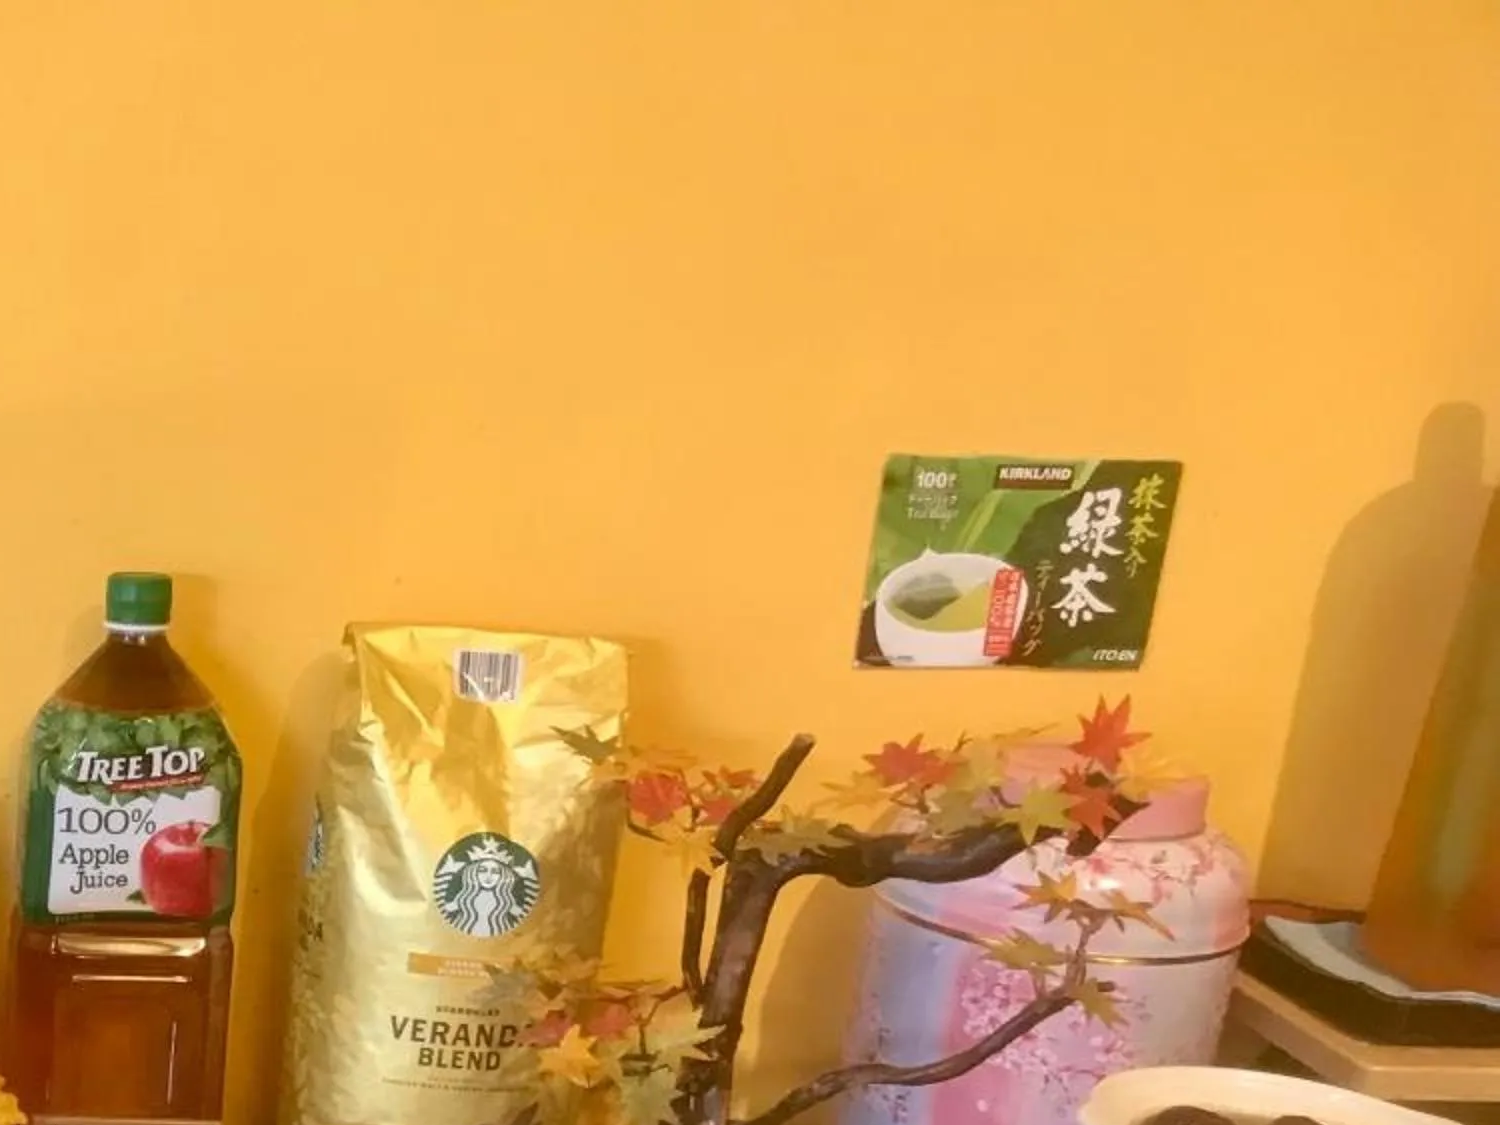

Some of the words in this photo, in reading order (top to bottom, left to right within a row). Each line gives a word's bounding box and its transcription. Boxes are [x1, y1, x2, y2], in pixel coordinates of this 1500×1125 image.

[998, 466, 1073, 482] KIRKLAND
[75, 751, 145, 785] TREE
[145, 745, 205, 778] TOP
[57, 807, 157, 835] 100%
[58, 843, 130, 869] Apple
[69, 870, 129, 895] Juice
[418, 1047, 501, 1071] BLEND
